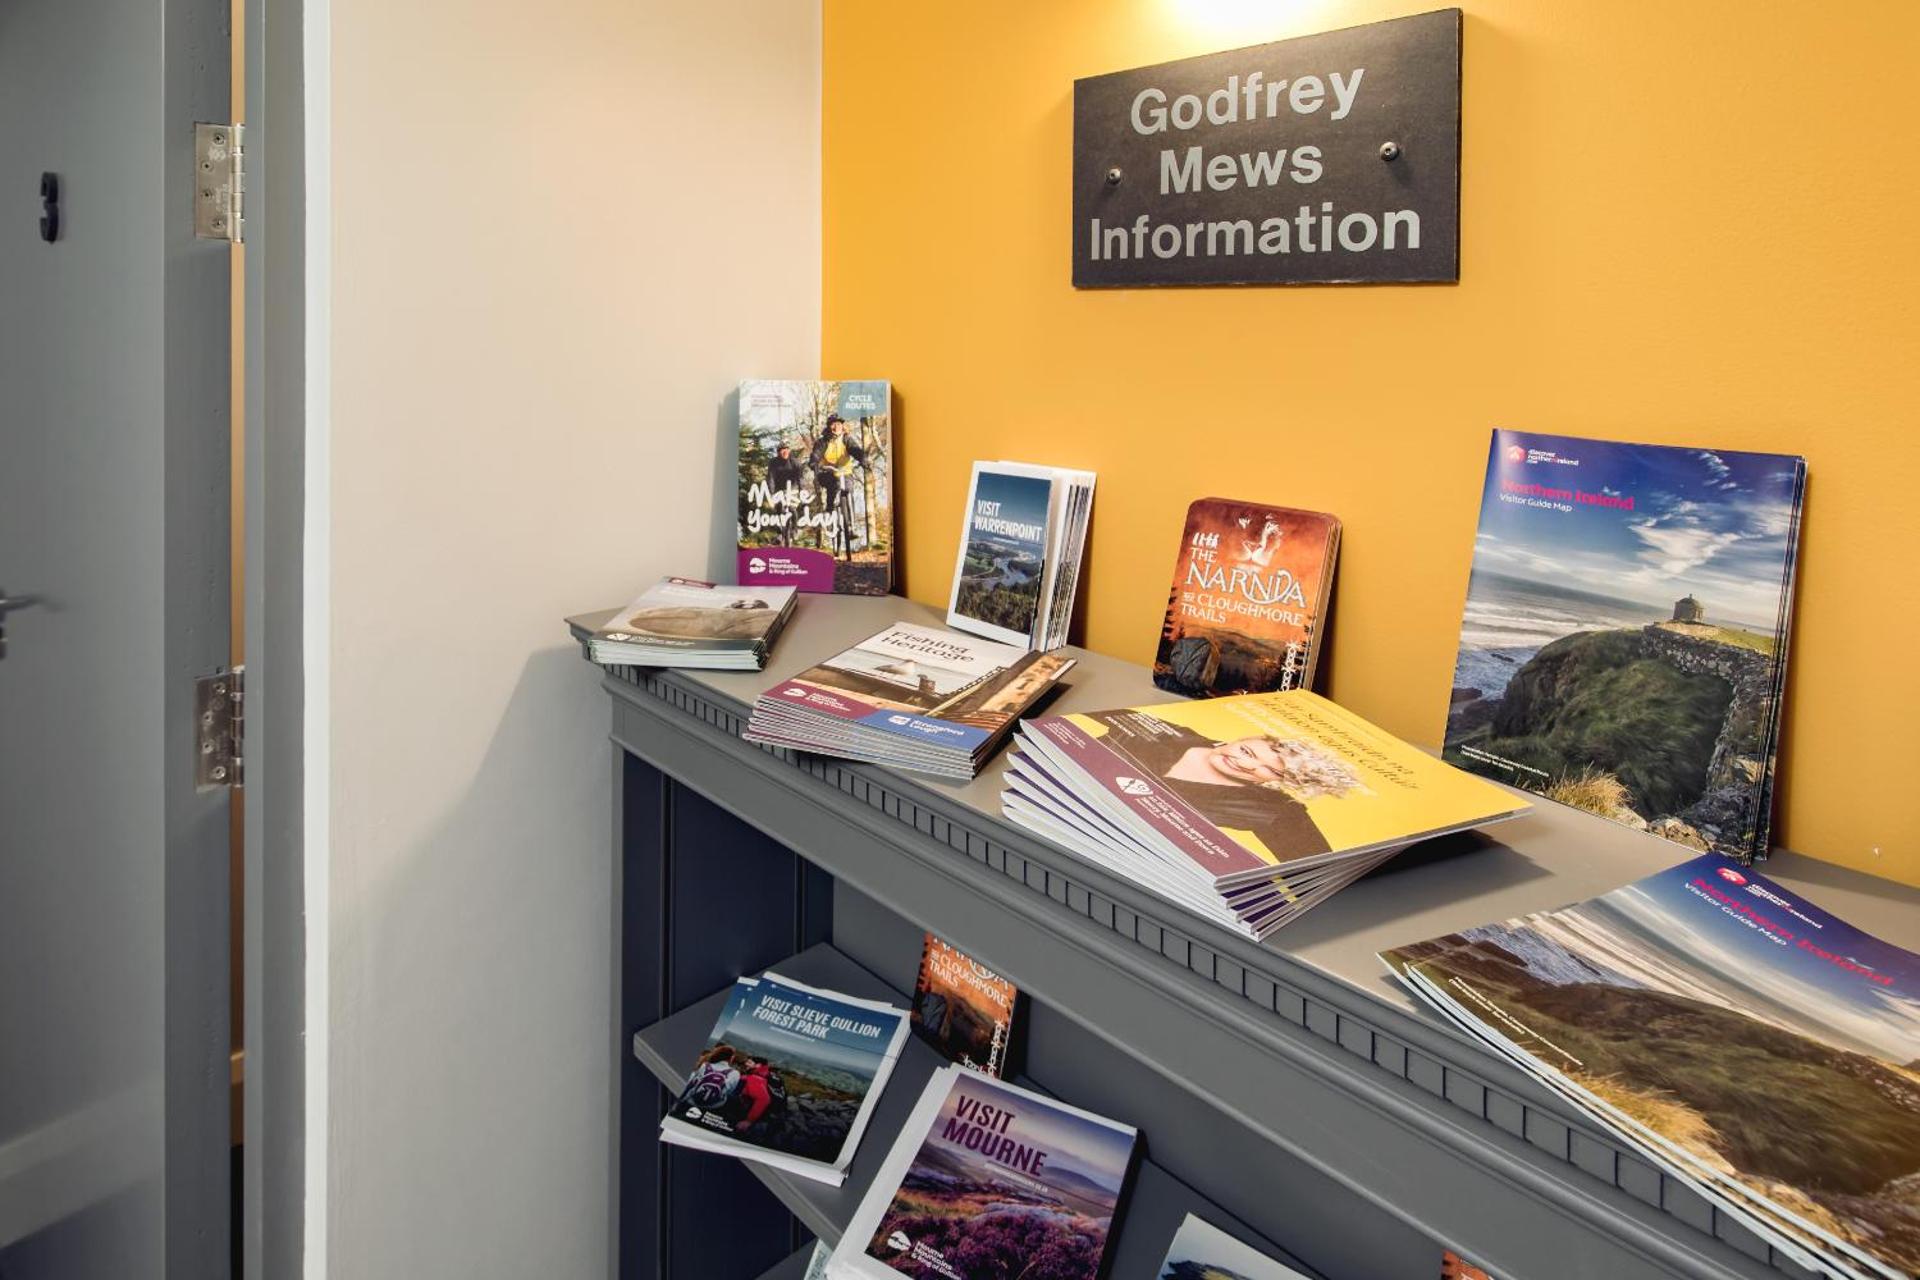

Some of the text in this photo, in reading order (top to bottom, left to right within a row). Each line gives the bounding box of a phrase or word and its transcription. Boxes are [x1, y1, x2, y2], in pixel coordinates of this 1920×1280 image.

[1130, 68, 1364, 136] Godfrey
[1160, 145, 1323, 195] Mews
[1091, 202, 1421, 261] Information
[845, 401, 877, 410] ROUTES
[848, 394, 873, 402] CYCLE
[748, 479, 817, 508] Make
[1500, 493, 1573, 513] Visitor Guide Map
[1502, 480, 1635, 511] Northern Ireland
[747, 508, 793, 533] your
[976, 501, 1001, 517] VISIT
[974, 515, 1043, 542] WARRENPOINT
[1190, 547, 1218, 563] THE
[1184, 560, 1307, 608] NARNIA
[1180, 602, 1227, 624] TRAILS
[1198, 594, 1305, 627] CLOUGHMORE
[881, 637, 975, 661] Heritage
[891, 631, 972, 654] Fishing
[1685, 882, 1787, 946] Visitor Guide Map
[1693, 878, 1895, 986] Northern Ireland
[930, 959, 959, 988] TRAILS
[940, 954, 1009, 1008] CLOUGHMORE
[752, 1006, 798, 1029] FOREST
[795, 1019, 830, 1039] PARK
[761, 995, 792, 1014] VISIT
[790, 1004, 831, 1025] SLIEVE
[955, 1095, 1015, 1134] VISIT
[942, 1118, 1049, 1177] MOURNE
[913, 1248, 953, 1271] Mountains
[915, 1241, 944, 1259] Mourne
